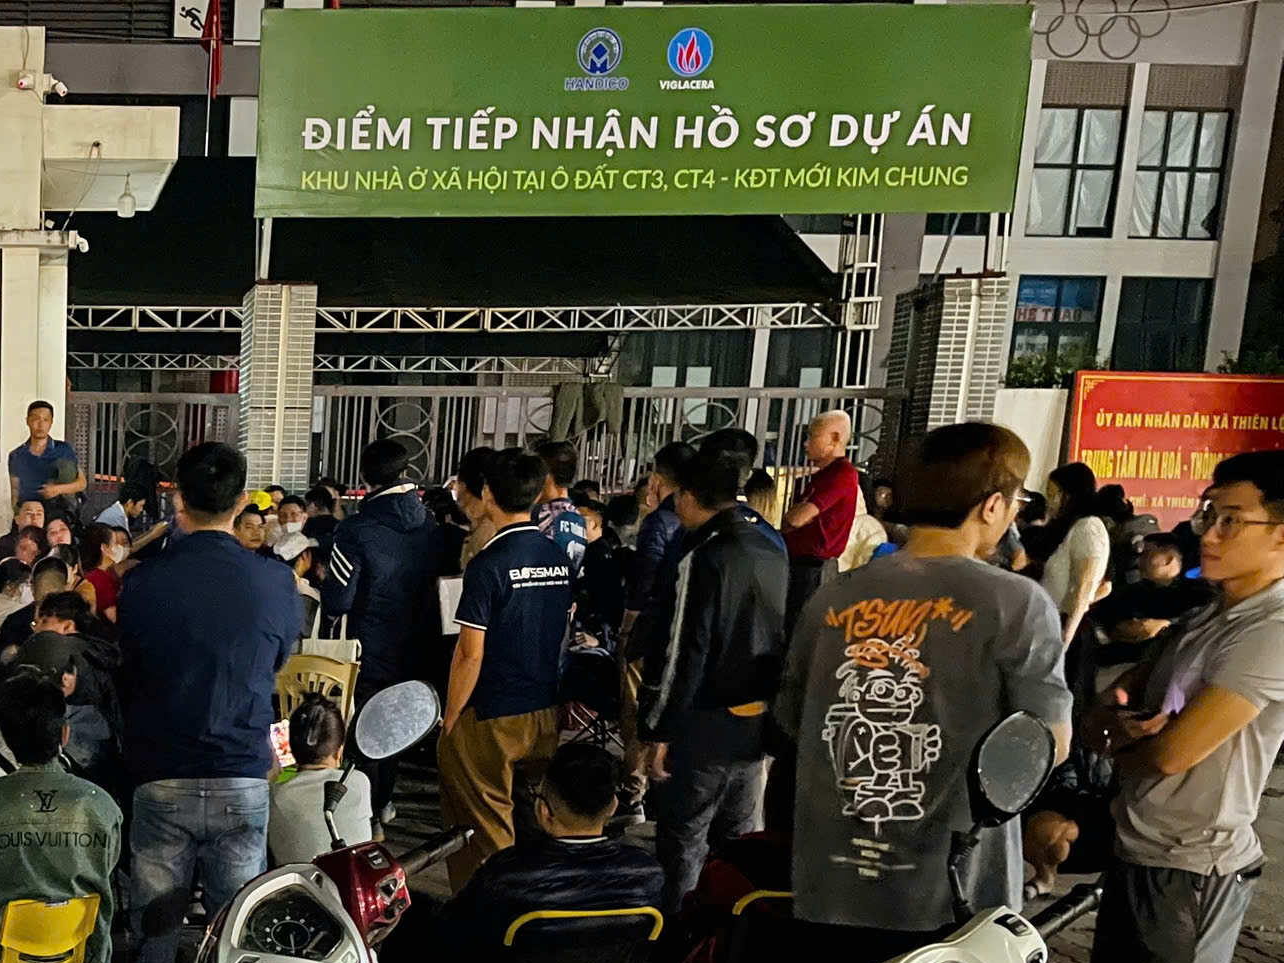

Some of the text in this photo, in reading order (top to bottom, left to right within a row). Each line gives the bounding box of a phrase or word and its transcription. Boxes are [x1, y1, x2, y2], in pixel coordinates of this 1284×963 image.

[564, 77, 715, 91] HANDICO VIGLACERA
[301, 104, 971, 157] ĐIỂM TIẾP NHẬN HỒ SƠ DỰ ÁN
[301, 170, 349, 190] KHU
[355, 165, 404, 190] NHÀ
[408, 166, 429, 190] Ở
[432, 166, 463, 190] XÃ
[467, 166, 508, 194] HỘI
[512, 170, 545, 194] TẠI
[551, 166, 569, 190] Ô
[574, 163, 619, 190] ĐẤT
[622, 169, 668, 192] CT3,
[673, 168, 715, 189] CT4
[734, 167, 781, 188] KĐT
[784, 162, 832, 188] MỚI
[836, 166, 880, 187] KIM
[884, 166, 969, 187] CHUNG
[1095, 408, 1113, 427] ỦY
[1116, 413, 1142, 428] BAN
[1144, 411, 1180, 428] NHÂN
[1183, 411, 1209, 429] DÂN
[1212, 413, 1229, 430] XÃ
[1232, 414, 1269, 430] THIÊN
[1116, 444, 1138, 479] TÂM
[35, 831, 107, 849] VUITTON
